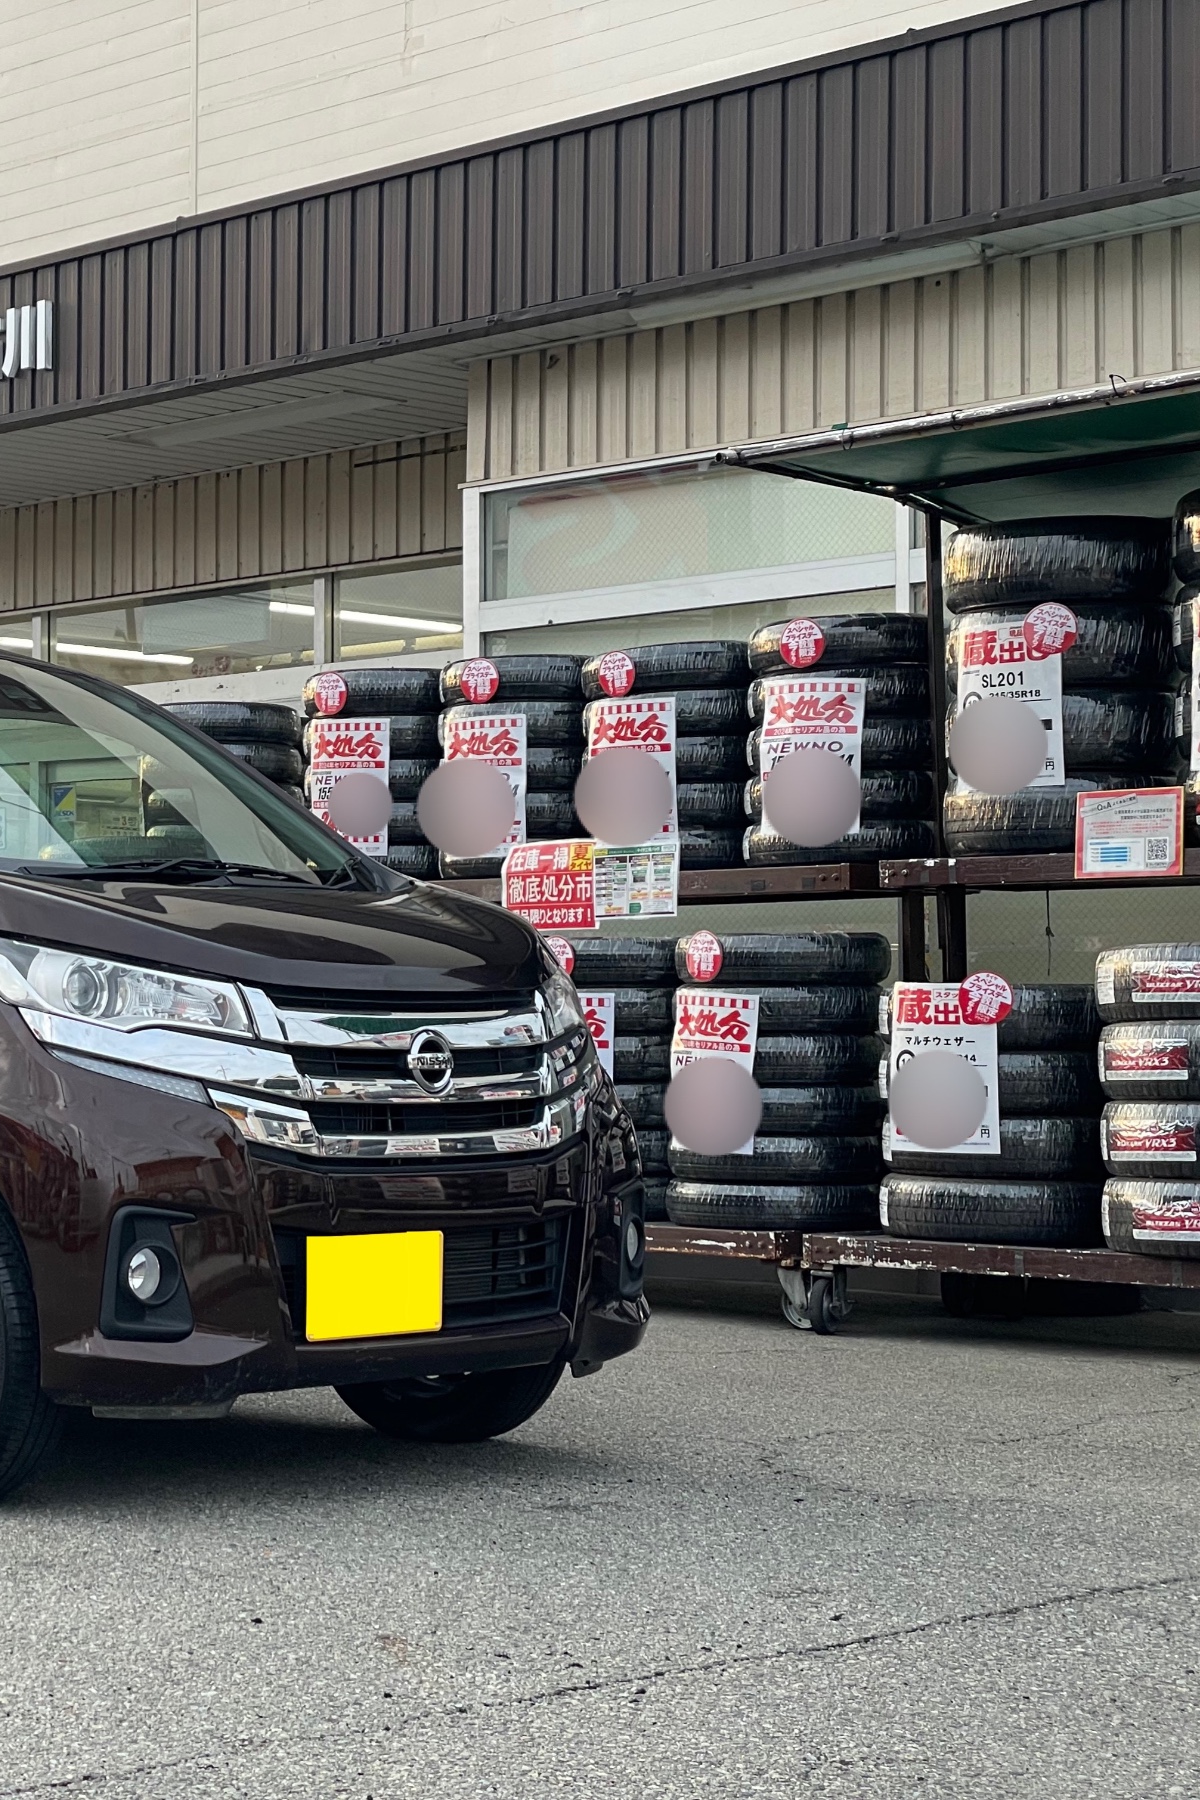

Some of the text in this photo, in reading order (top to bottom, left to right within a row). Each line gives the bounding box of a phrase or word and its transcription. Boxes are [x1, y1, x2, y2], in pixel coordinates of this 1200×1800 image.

[981, 671, 1024, 688] SL201
[768, 694, 856, 726] 大処分
[592, 713, 668, 746] 大処分
[314, 732, 383, 759] 大処分
[448, 728, 519, 760] 大処分
[511, 847, 568, 872] 在庫一掃
[571, 845, 591, 861] 夏
[570, 861, 591, 870] タイヤ
[509, 873, 593, 904] 徹底処分市
[935, 991, 959, 999] スタッ
[677, 1005, 750, 1041] 大処分
[905, 1036, 975, 1046] マルチウェザー
[417, 1056, 454, 1068] NISSAN
[1139, 1057, 1169, 1067] VRX3
[1145, 1138, 1177, 1147] VRX3
